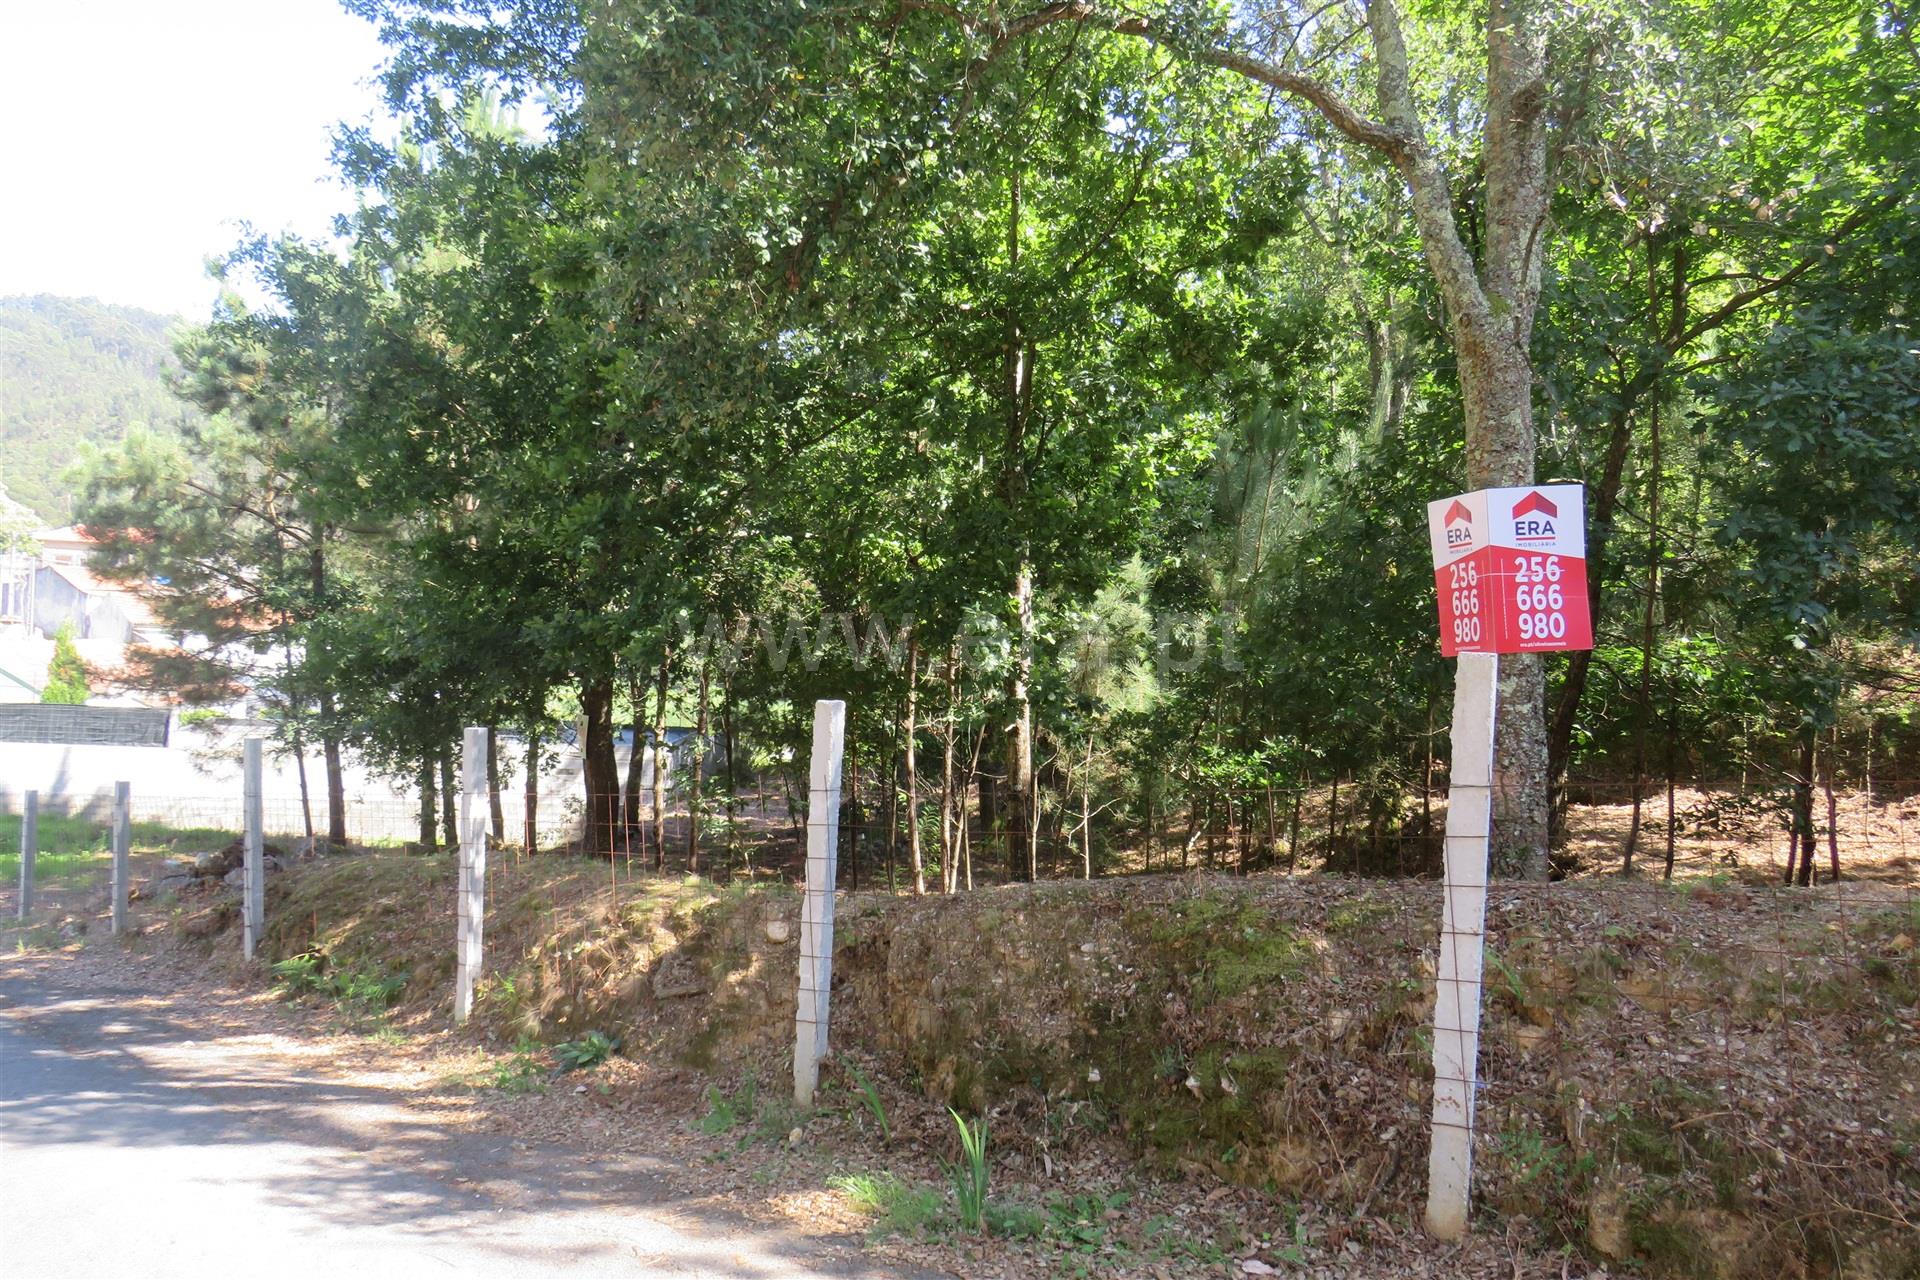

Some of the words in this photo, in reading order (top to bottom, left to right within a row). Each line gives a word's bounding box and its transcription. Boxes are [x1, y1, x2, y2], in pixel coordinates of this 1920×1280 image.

[1447, 527, 1472, 544] ERA
[1515, 520, 1556, 536] ERA
[1450, 560, 1478, 589] 256
[1514, 555, 1561, 583] 256
[1452, 588, 1479, 616] 666
[1516, 584, 1563, 611] 666
[1453, 616, 1480, 643] 980
[1518, 612, 1566, 640] 980
